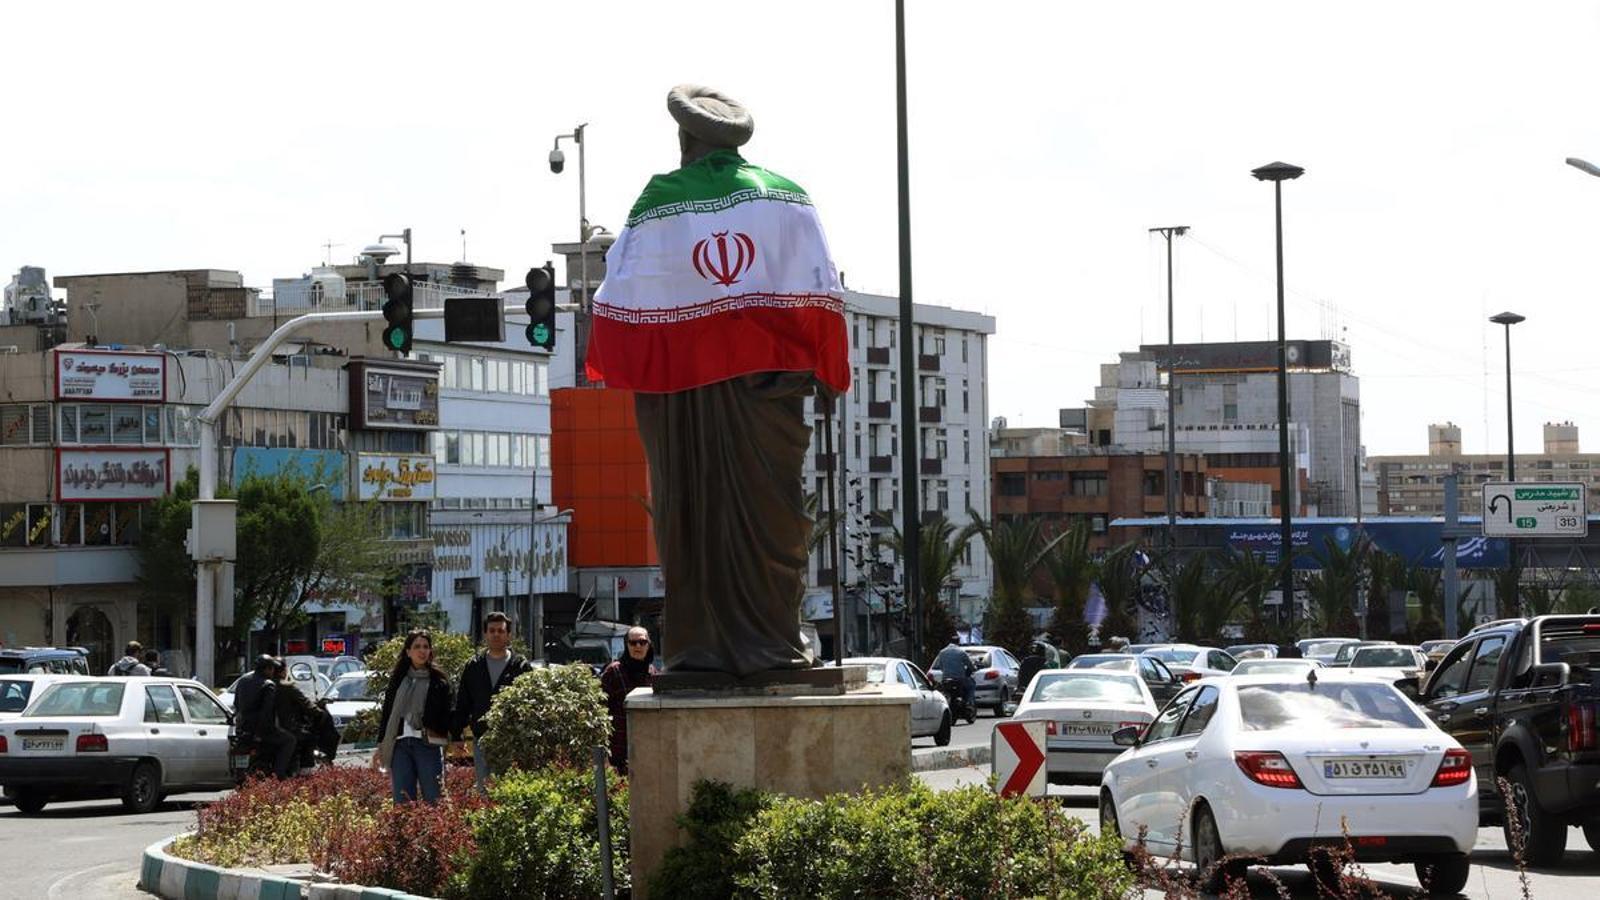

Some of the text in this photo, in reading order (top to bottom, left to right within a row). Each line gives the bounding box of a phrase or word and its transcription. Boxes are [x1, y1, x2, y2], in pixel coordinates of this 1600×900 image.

[1517, 488, 1569, 500] شهید مدرس
[1537, 501, 1569, 513] شریعتی
[1521, 518, 1533, 528] 15
[1560, 517, 1577, 528] 313
[1334, 763, 1348, 775] ۵۱
[1389, 765, 1404, 776] ۹۹
